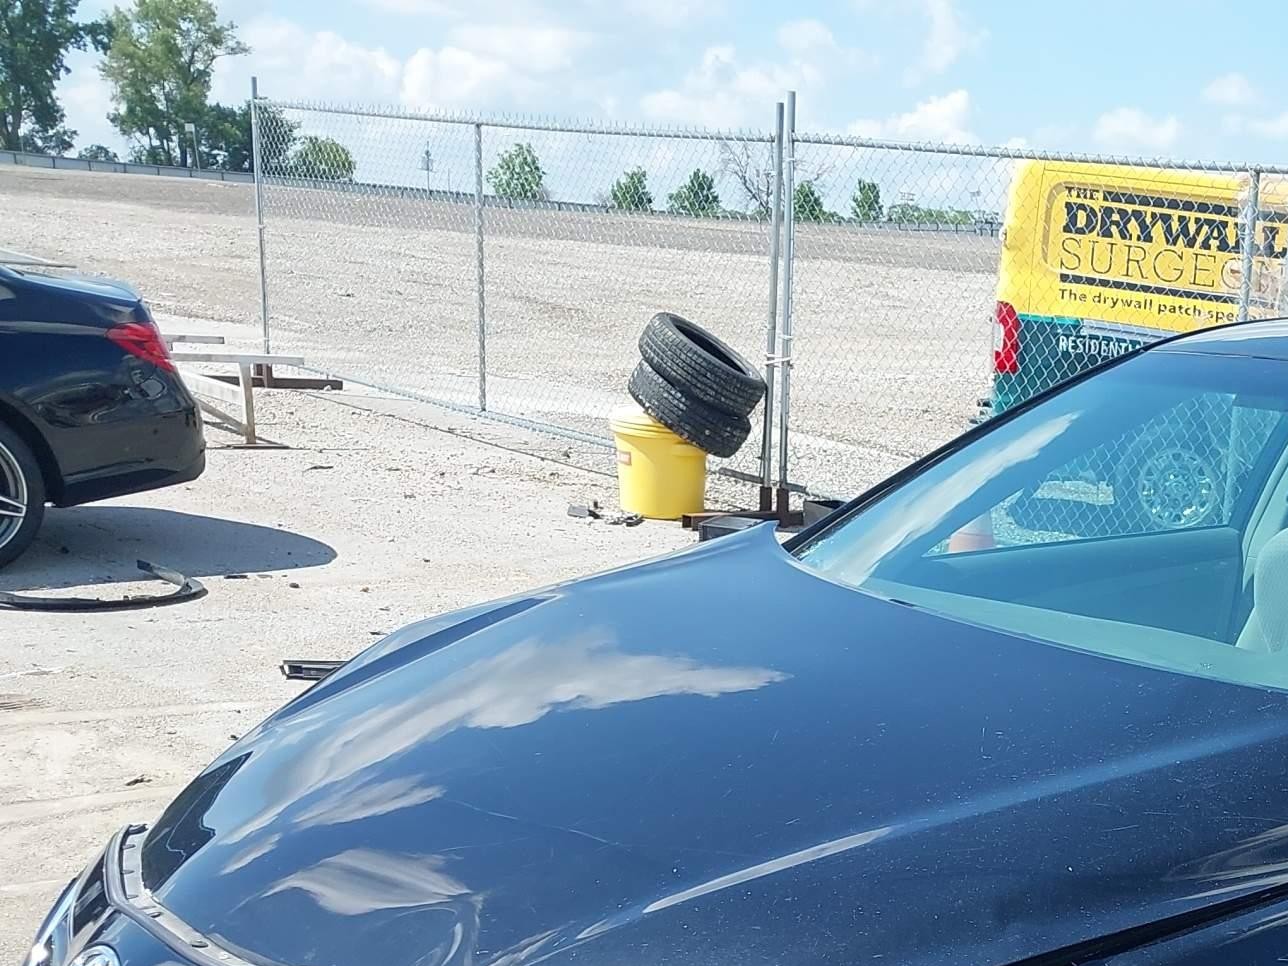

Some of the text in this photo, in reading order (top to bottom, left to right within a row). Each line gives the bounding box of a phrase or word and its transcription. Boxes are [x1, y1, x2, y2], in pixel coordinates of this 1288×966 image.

[1064, 186, 1100, 200] THE
[1062, 201, 1288, 259] DRYWALL
[1059, 288, 1087, 302] The
[1092, 292, 1153, 311] drywall
[1157, 302, 1202, 318] patch
